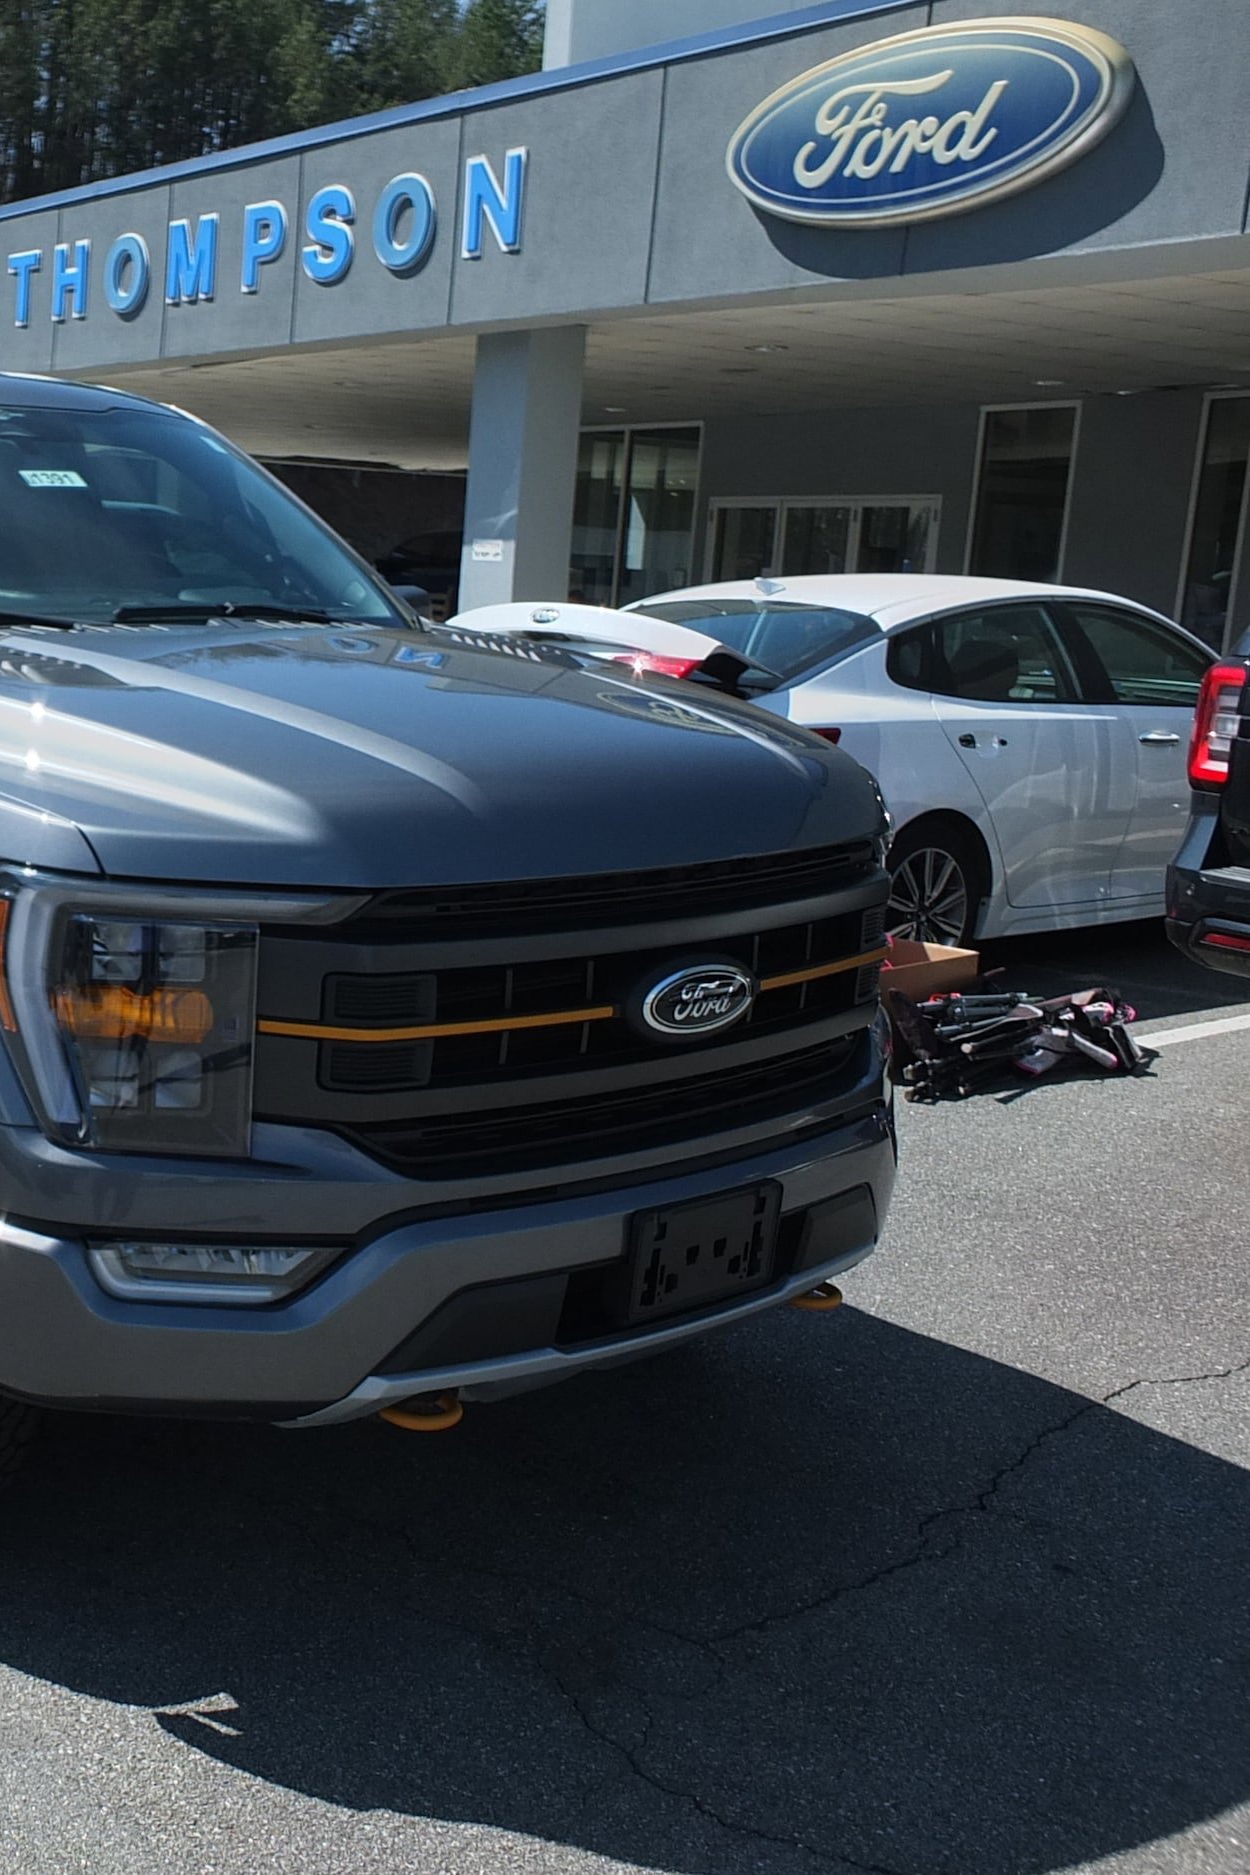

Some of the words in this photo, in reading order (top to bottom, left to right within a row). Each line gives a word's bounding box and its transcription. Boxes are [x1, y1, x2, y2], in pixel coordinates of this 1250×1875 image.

[793, 69, 1010, 190] Ford
[6, 145, 529, 328] THOMPSON
[673, 980, 735, 1021] Ford
